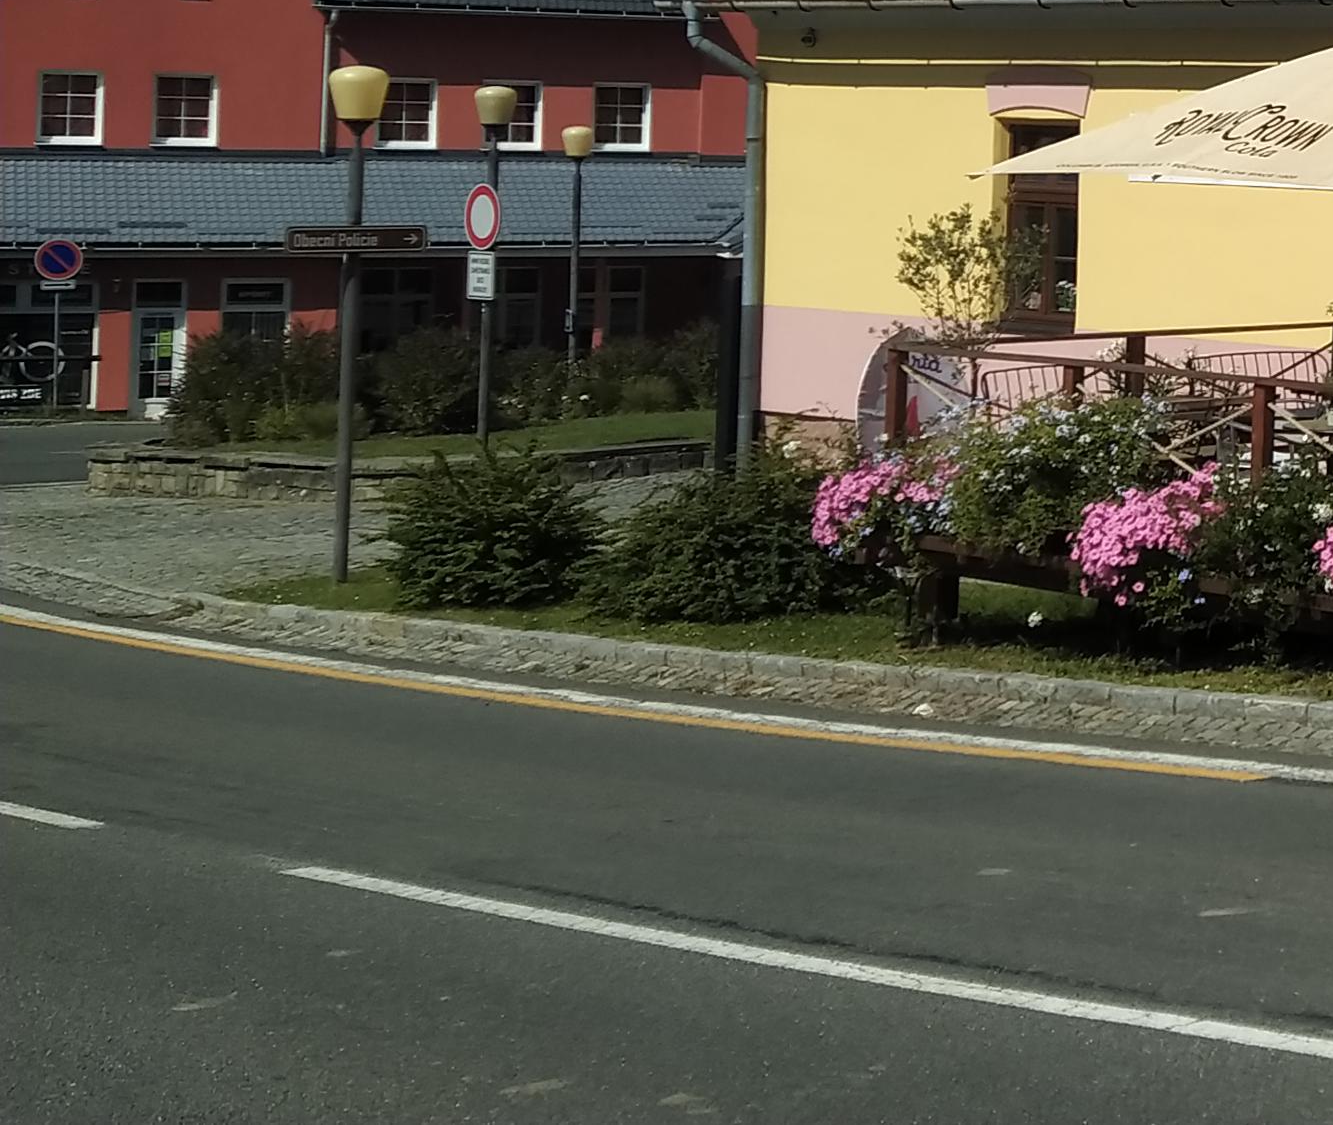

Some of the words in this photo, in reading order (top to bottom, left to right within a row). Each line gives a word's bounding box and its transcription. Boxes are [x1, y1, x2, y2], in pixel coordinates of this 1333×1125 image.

[1155, 108, 1243, 146] ROYAL
[1222, 103, 1333, 151] CROWN
[1224, 141, 1278, 158] Cola
[293, 232, 336, 248] Obecní
[338, 232, 379, 247] Policie
